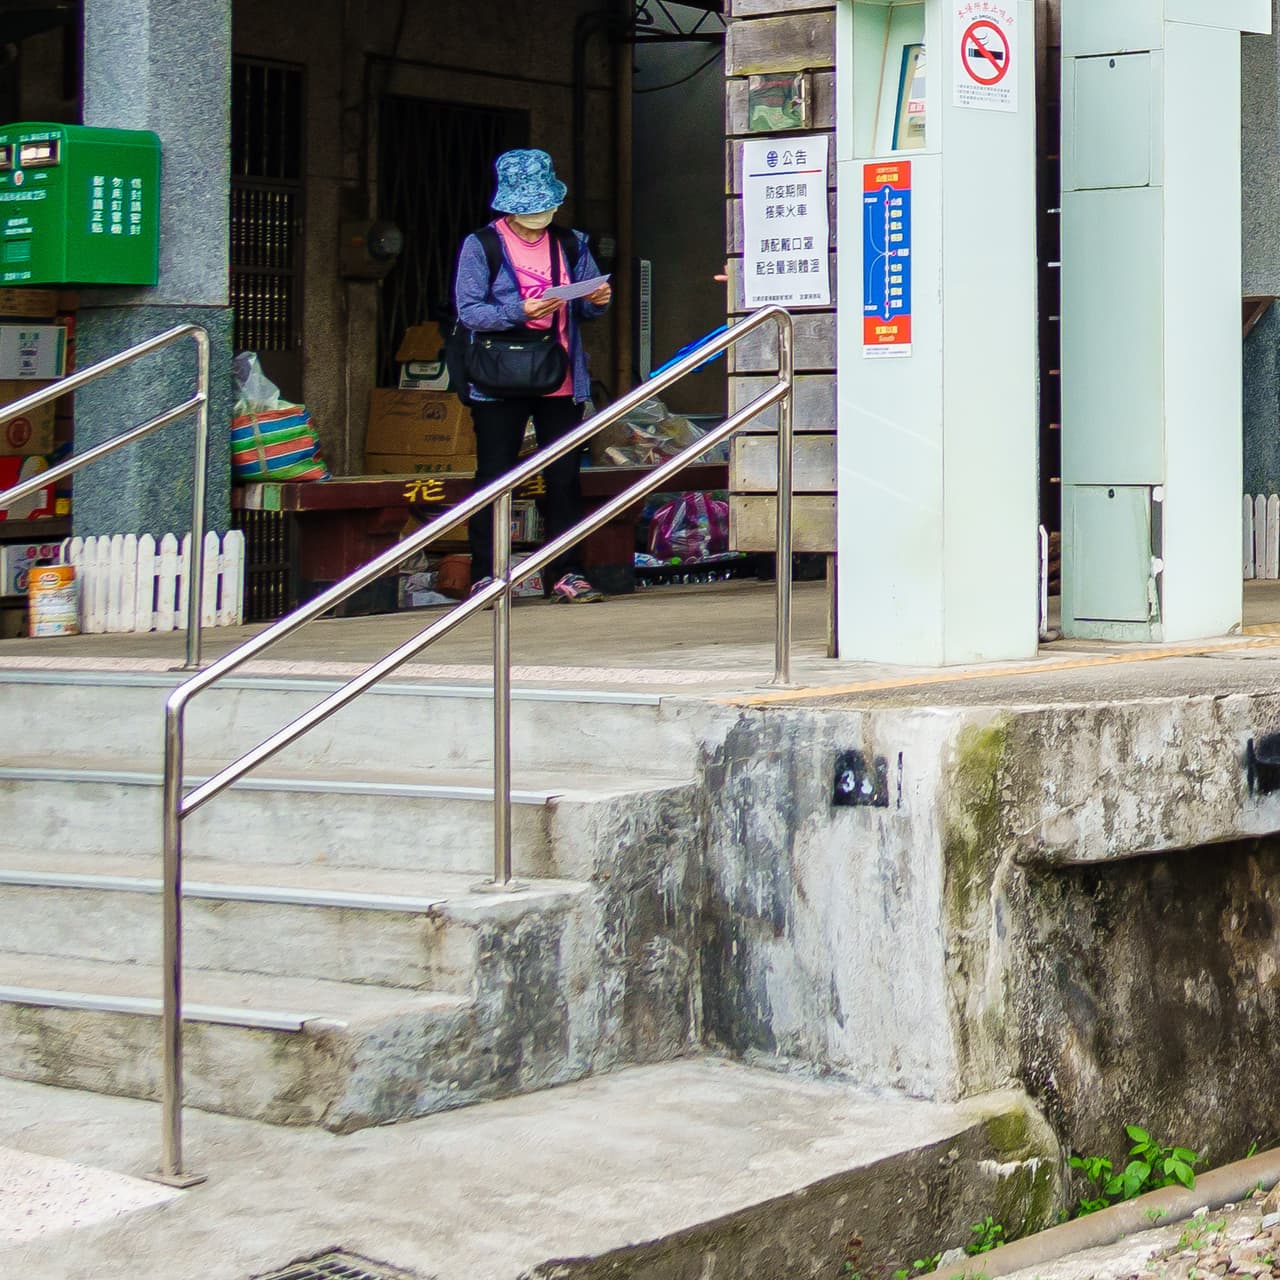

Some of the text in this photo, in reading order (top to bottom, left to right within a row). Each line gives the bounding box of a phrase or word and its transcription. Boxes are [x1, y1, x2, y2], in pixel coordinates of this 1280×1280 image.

[782, 149, 808, 166] 公告
[765, 183, 808, 199] 防疫期間
[765, 203, 808, 219] 搭乘火車
[756, 258, 820, 276] 配合量測體溫
[403, 479, 446, 502] 花
